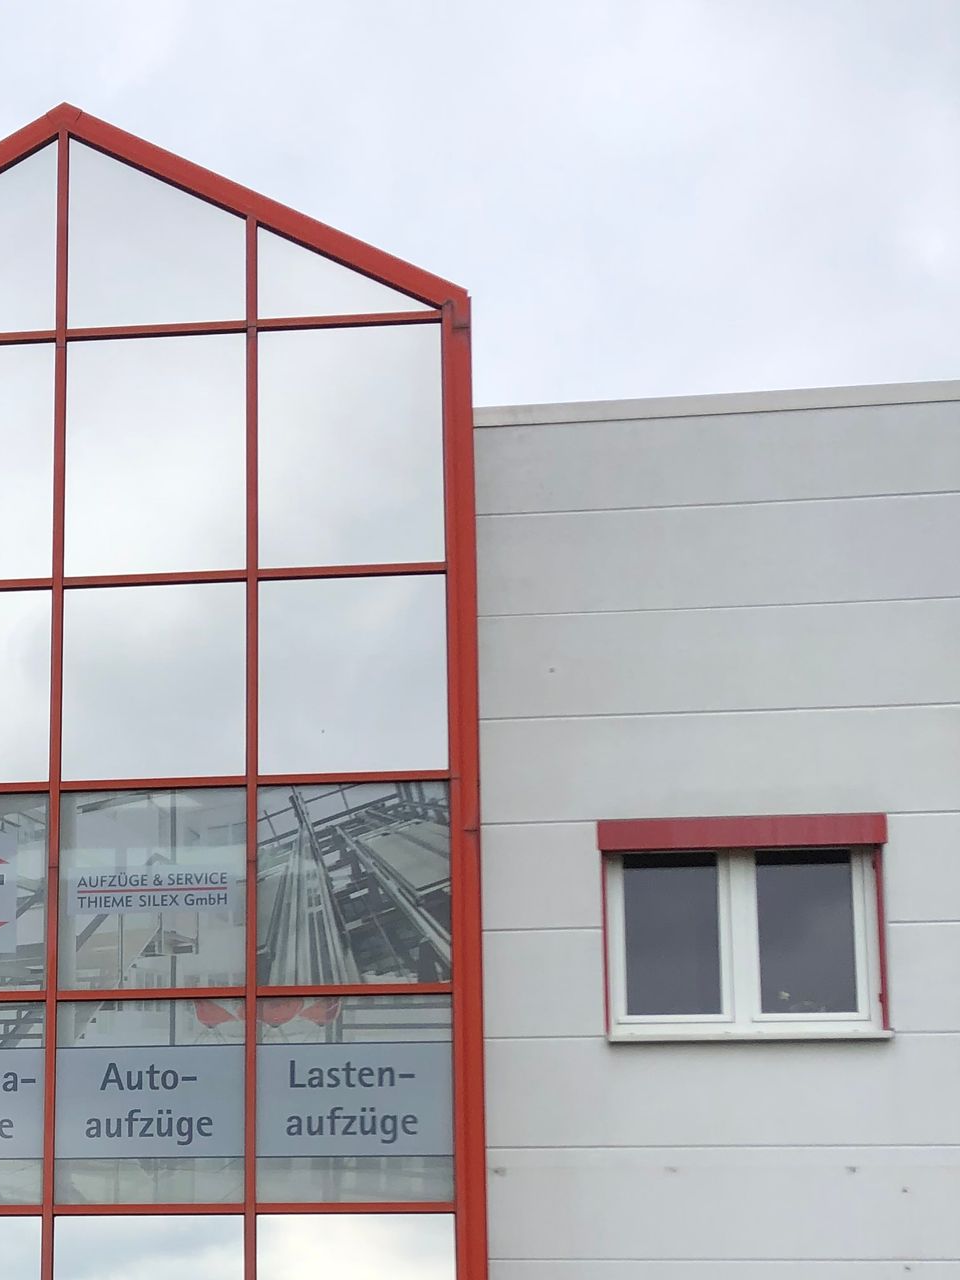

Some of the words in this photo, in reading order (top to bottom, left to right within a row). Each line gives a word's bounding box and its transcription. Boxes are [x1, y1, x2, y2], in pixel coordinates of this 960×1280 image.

[77, 872, 148, 888] AUFZÜGE
[153, 874, 163, 886] &
[167, 872, 228, 886] SERVICE
[77, 895, 133, 908] THIEME
[138, 894, 179, 907] SILEX
[184, 893, 228, 906] GmbH
[100, 1062, 198, 1091] Auto-
[289, 1060, 416, 1089] Lasten-
[85, 1109, 214, 1146] aufzüge
[285, 1106, 419, 1144] aufzüge
